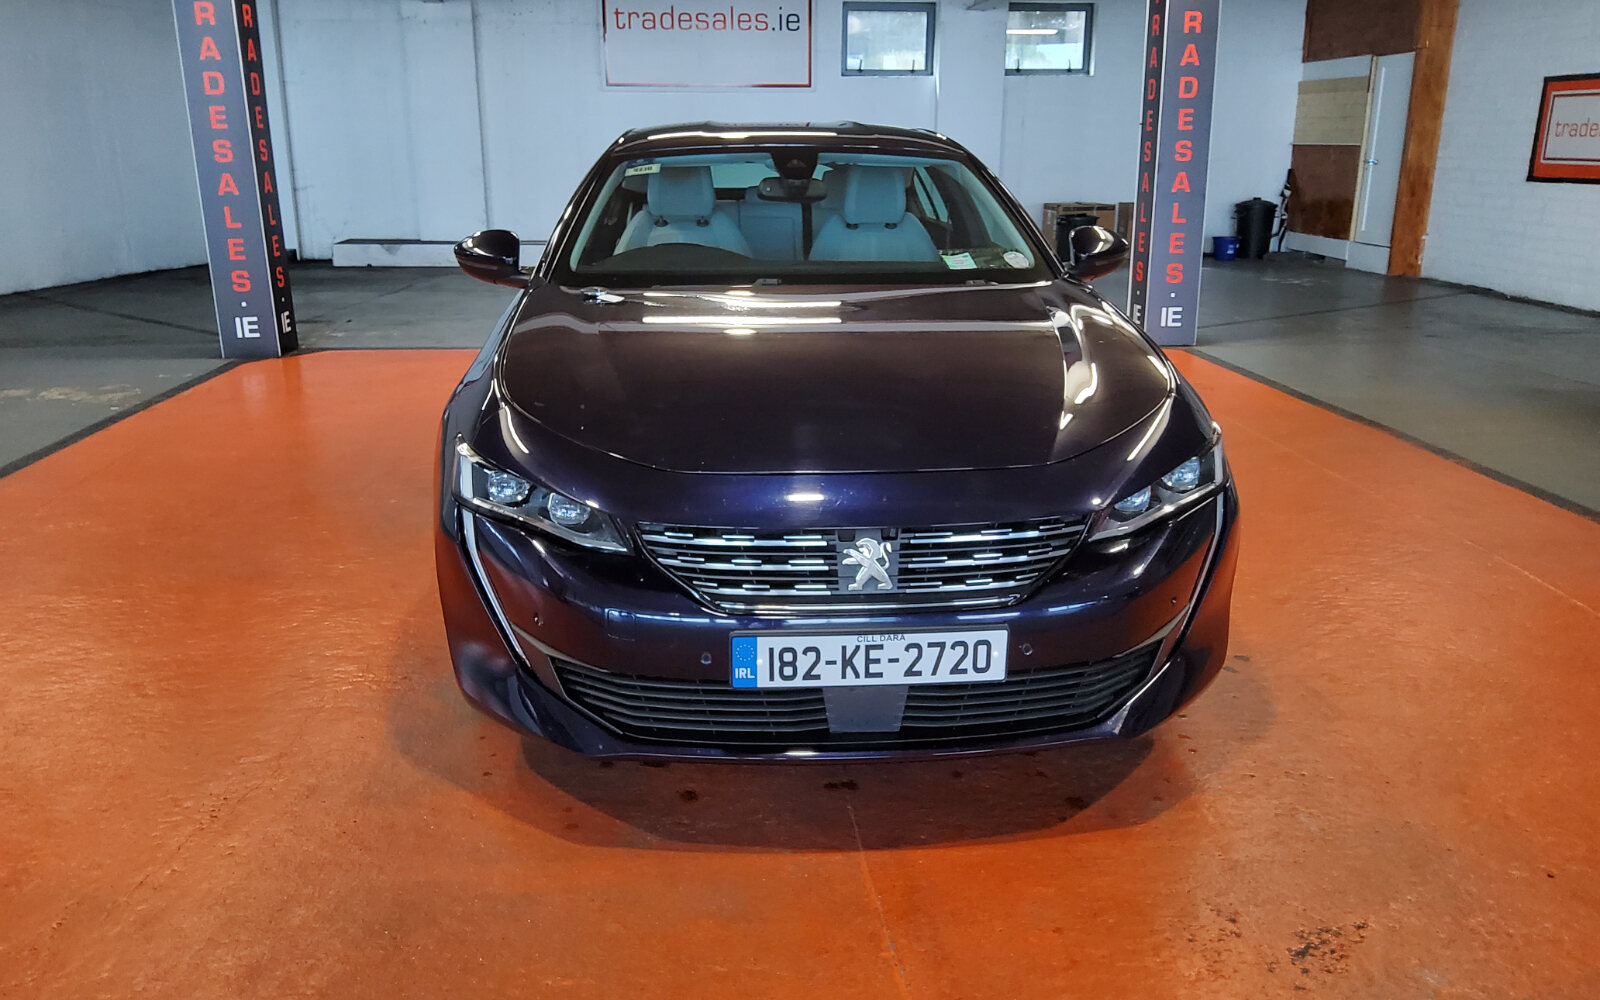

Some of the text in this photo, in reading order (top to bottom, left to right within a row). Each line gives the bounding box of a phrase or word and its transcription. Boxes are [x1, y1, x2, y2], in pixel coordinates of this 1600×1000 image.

[613, 5, 801, 31] tradesales.ie
[1554, 117, 1600, 137] trade
[242, 0, 292, 334] RADESALES.IE
[1132, 0, 1161, 325] RADESALES.IE
[1160, 0, 1203, 327] RADESALES.IE
[856, 633, 906, 643] CILL DARA
[735, 667, 755, 679] IRL
[768, 639, 992, 682] 182-KE-2720
